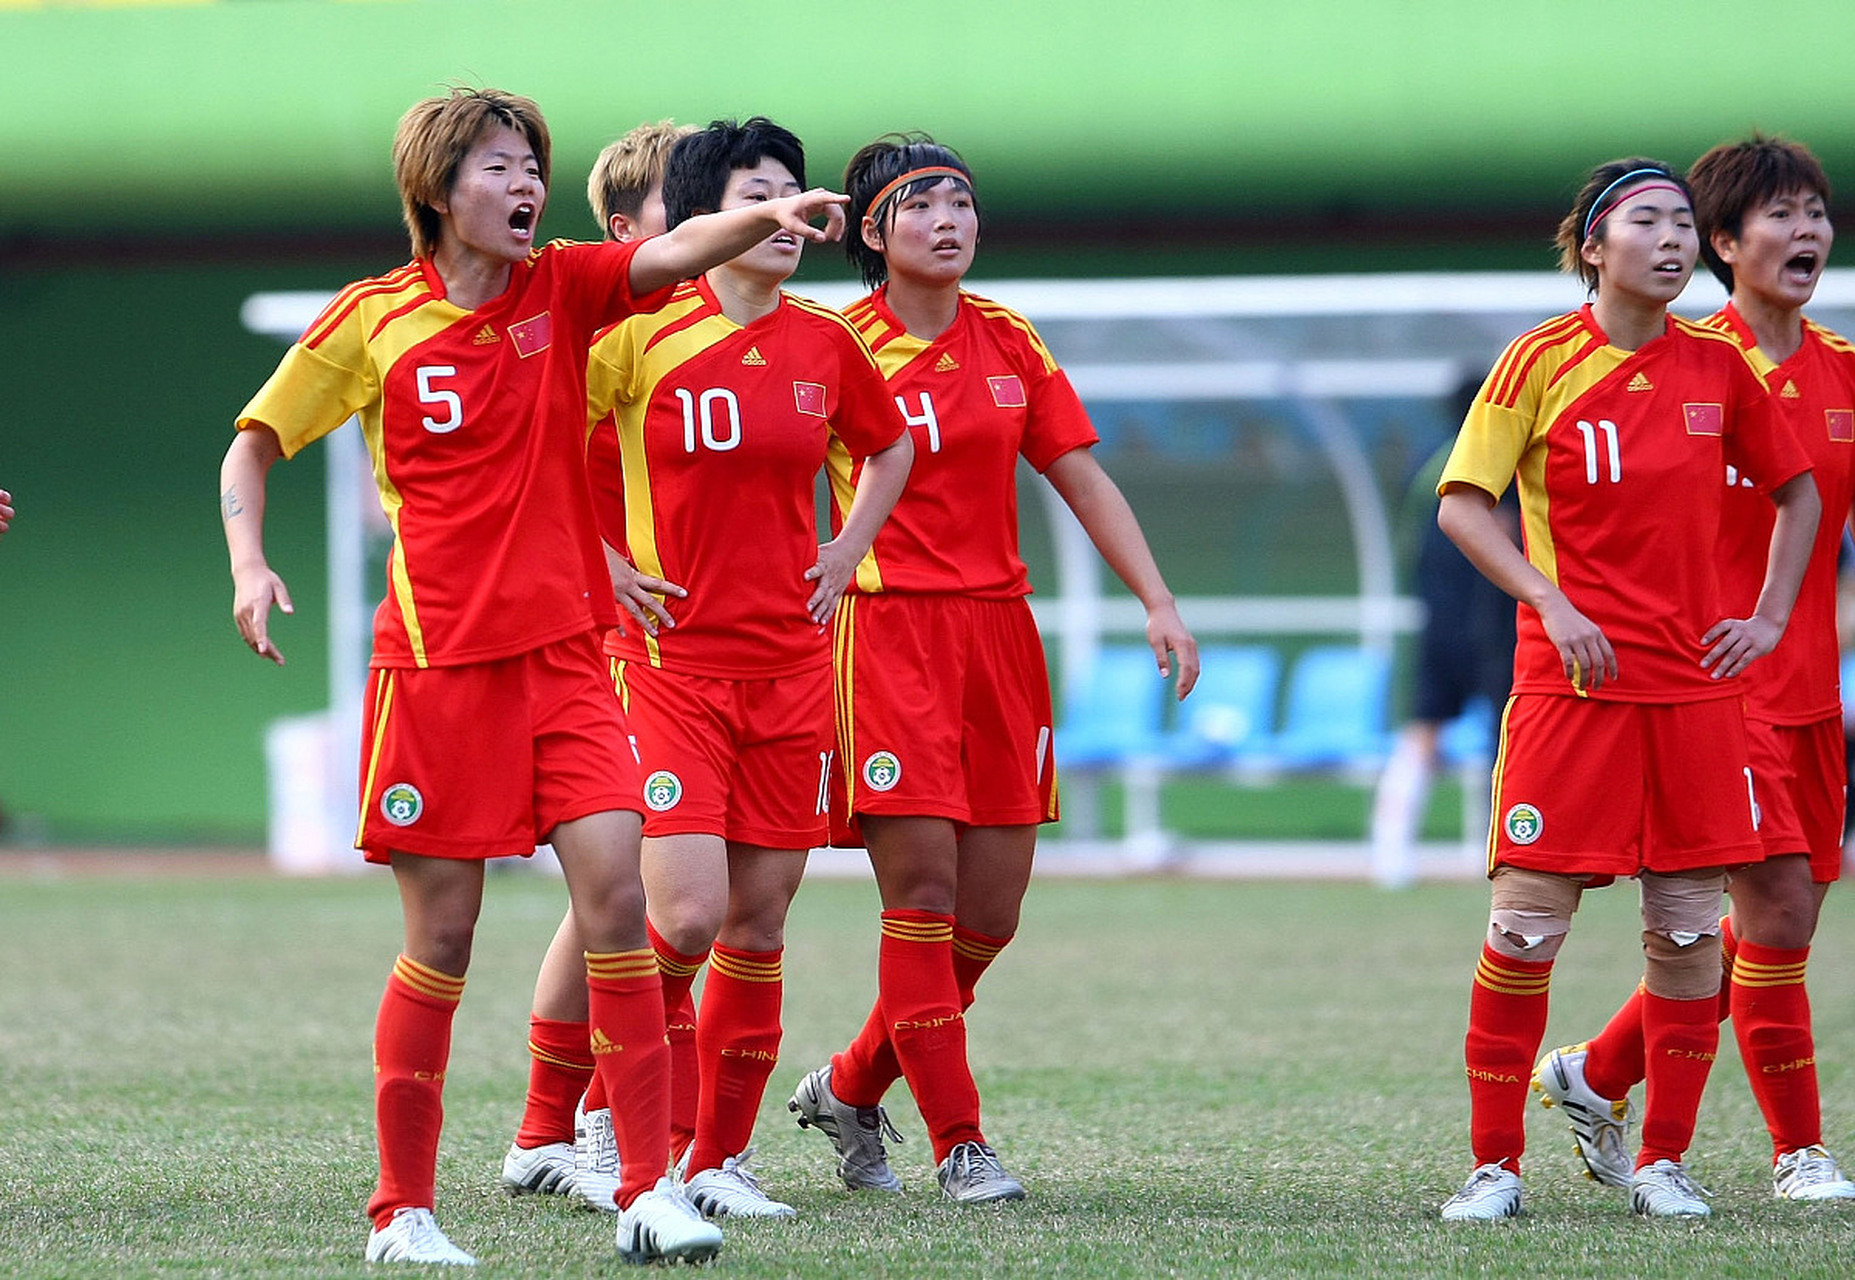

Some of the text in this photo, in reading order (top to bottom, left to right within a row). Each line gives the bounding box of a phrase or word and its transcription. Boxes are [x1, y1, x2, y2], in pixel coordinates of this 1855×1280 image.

[415, 365, 464, 434] 5
[674, 387, 741, 453] 10
[1576, 419, 1622, 485] 11
